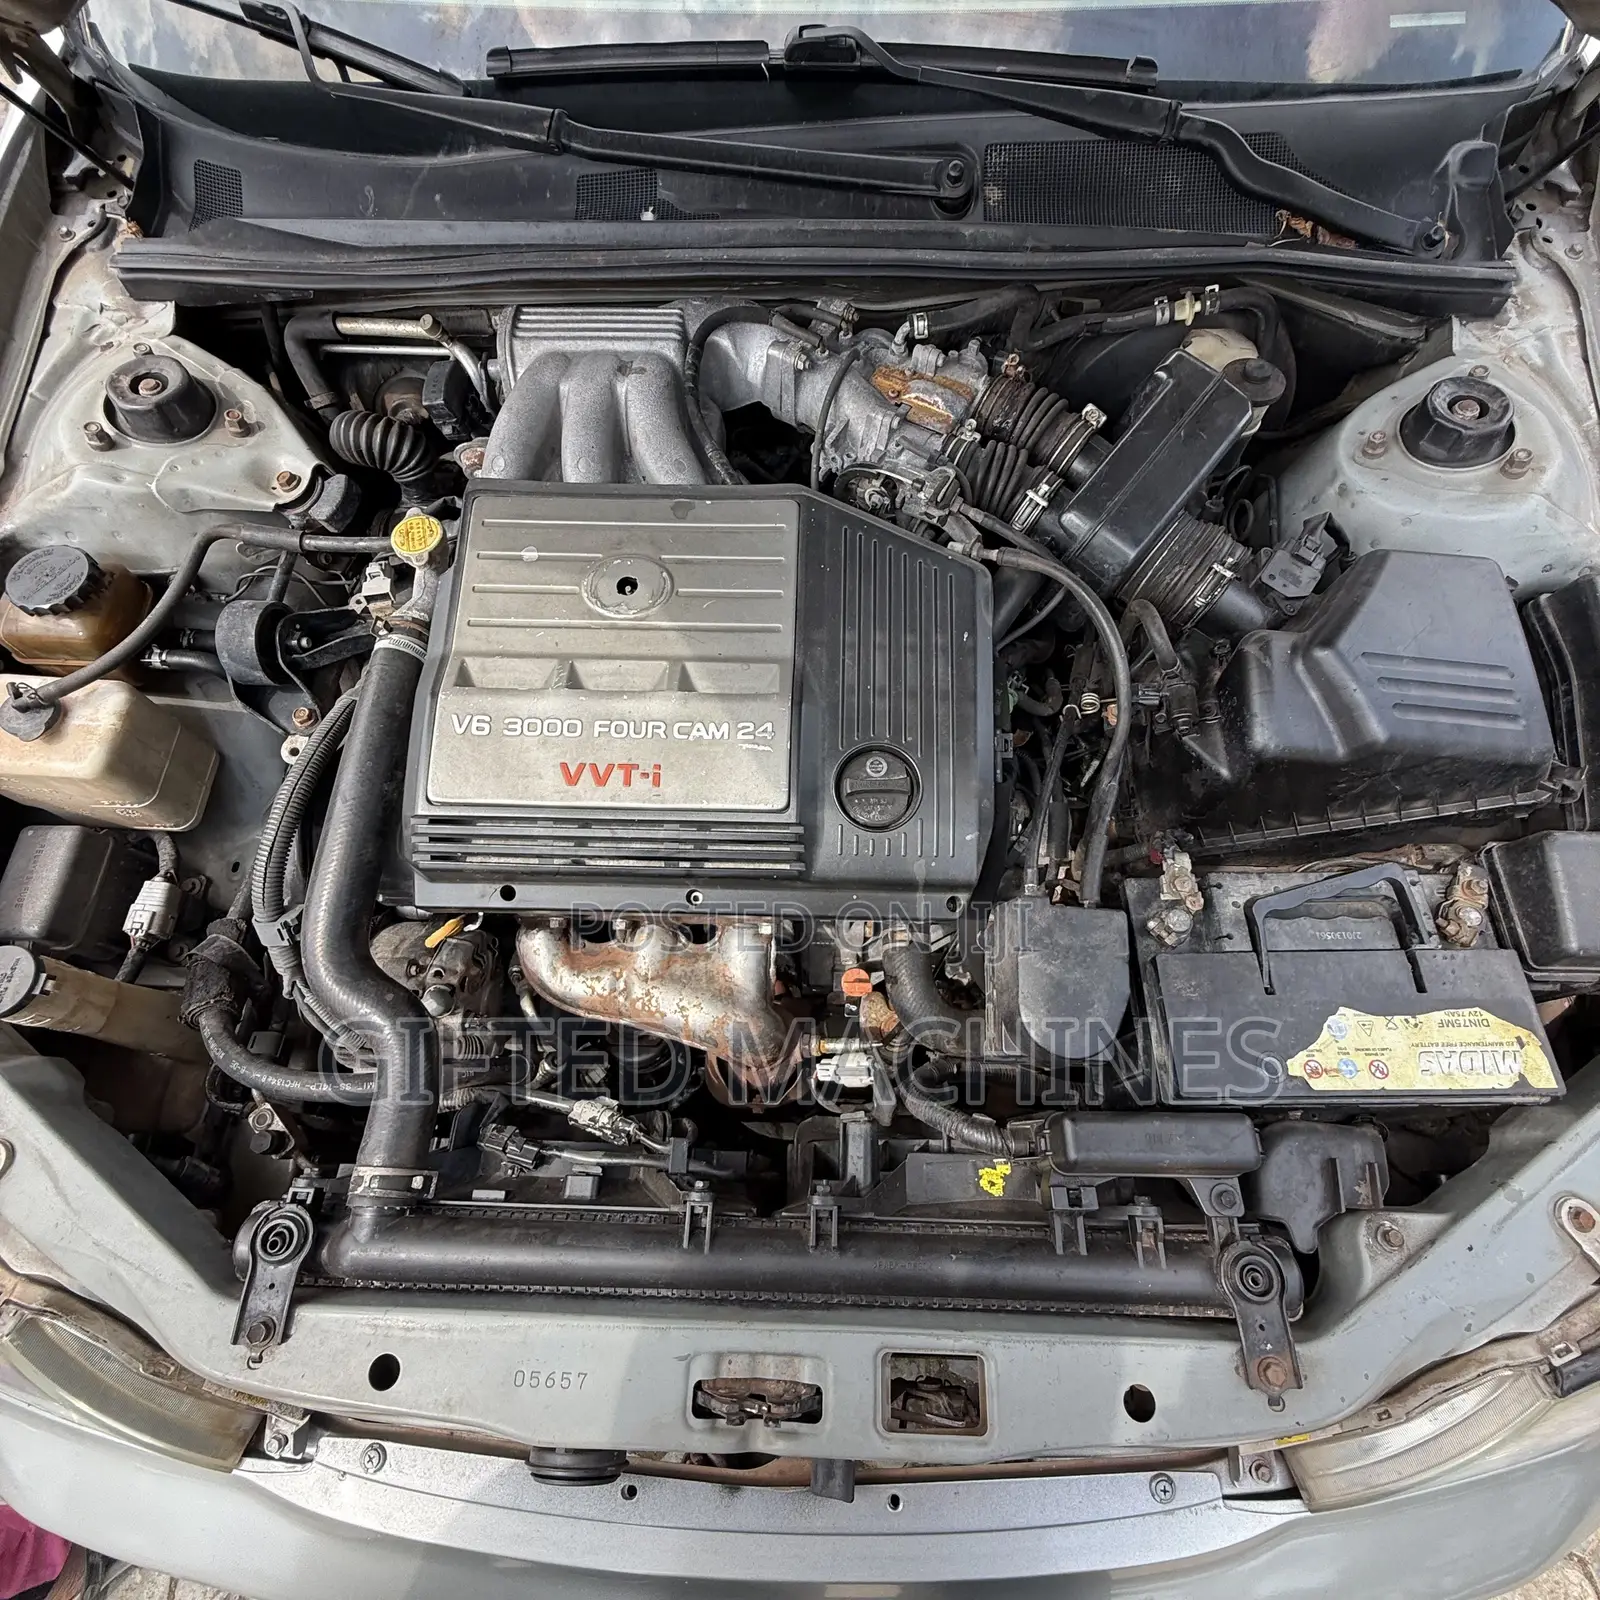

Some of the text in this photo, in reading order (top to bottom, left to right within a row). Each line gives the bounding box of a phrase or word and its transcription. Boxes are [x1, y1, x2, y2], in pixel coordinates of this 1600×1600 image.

[451, 713, 775, 741] V6 3000 FOUR CAM 24
[559, 762, 662, 788] VVT-i
[1437, 1018, 1491, 1028] DIN75MF
[1418, 1049, 1522, 1076] MIDAS
[513, 1369, 588, 1390] 05657
